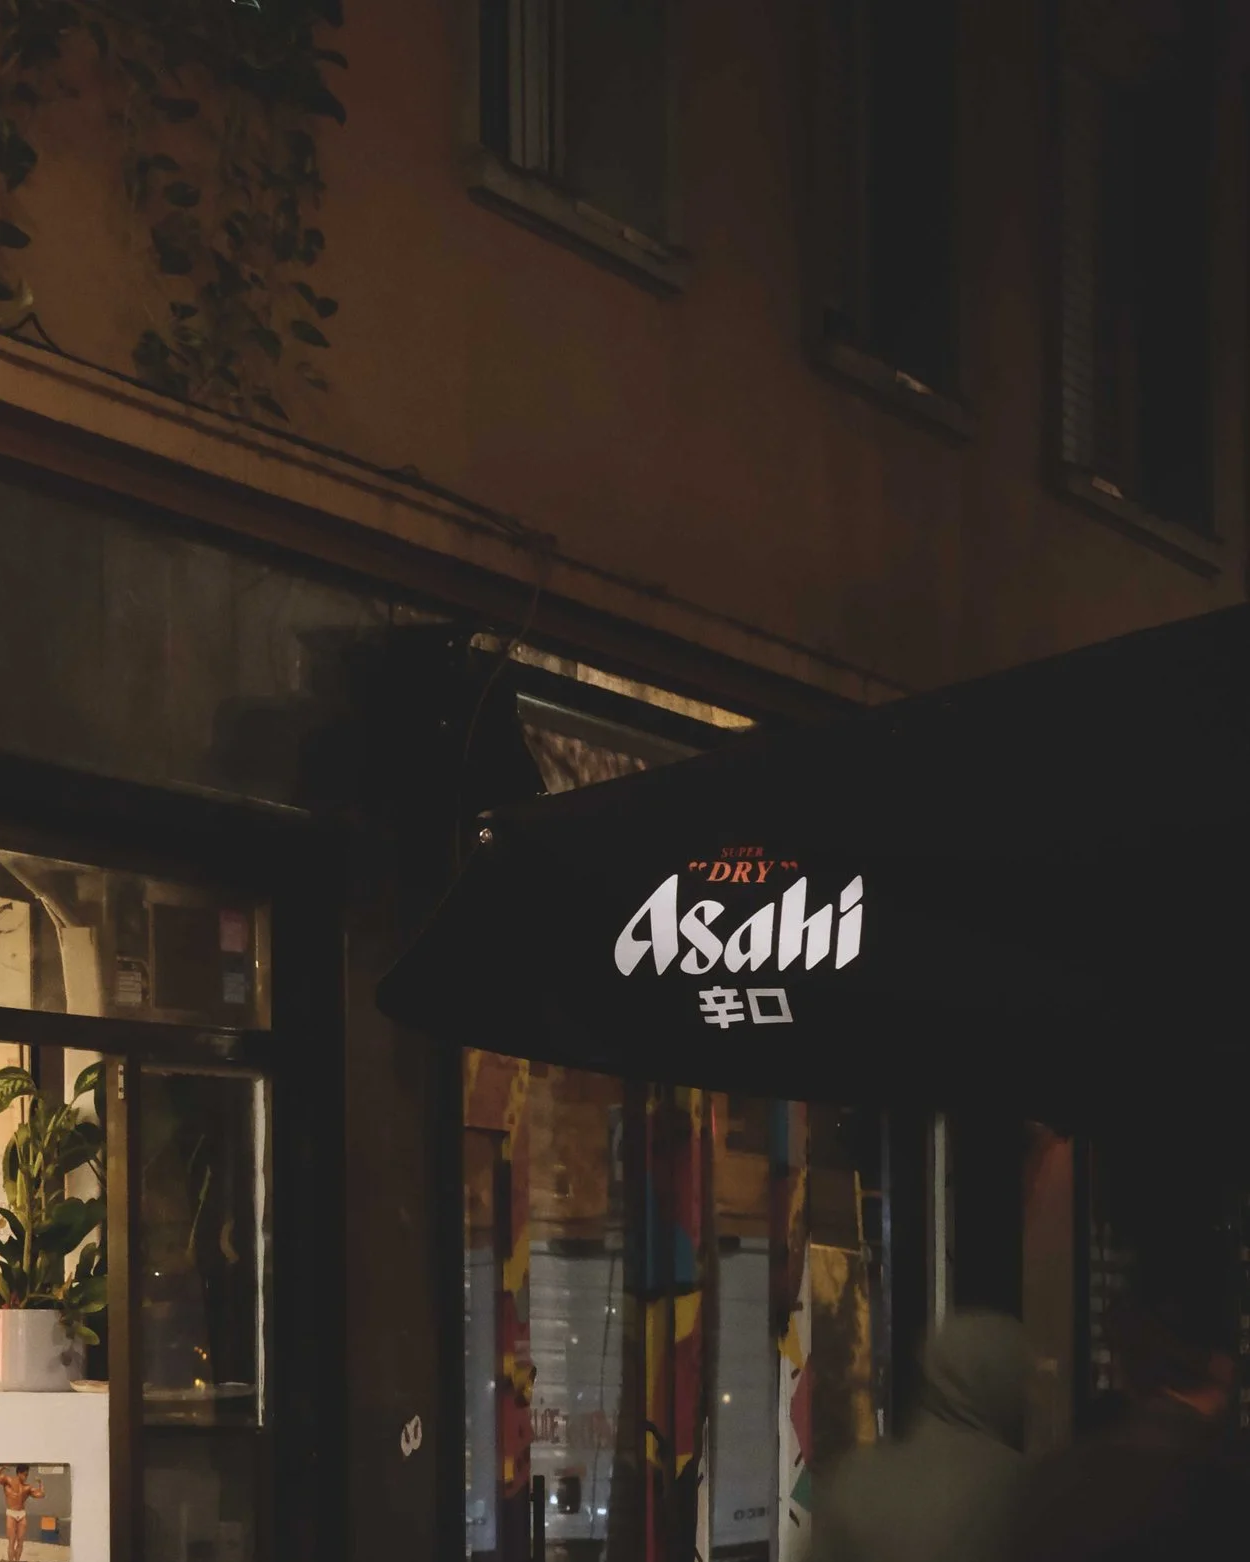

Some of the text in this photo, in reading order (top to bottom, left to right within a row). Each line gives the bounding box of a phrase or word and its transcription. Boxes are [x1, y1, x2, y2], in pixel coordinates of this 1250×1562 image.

[720, 846, 764, 858] SUPER
[614, 873, 864, 977] Asahi
[698, 985, 794, 1029] 辛口
